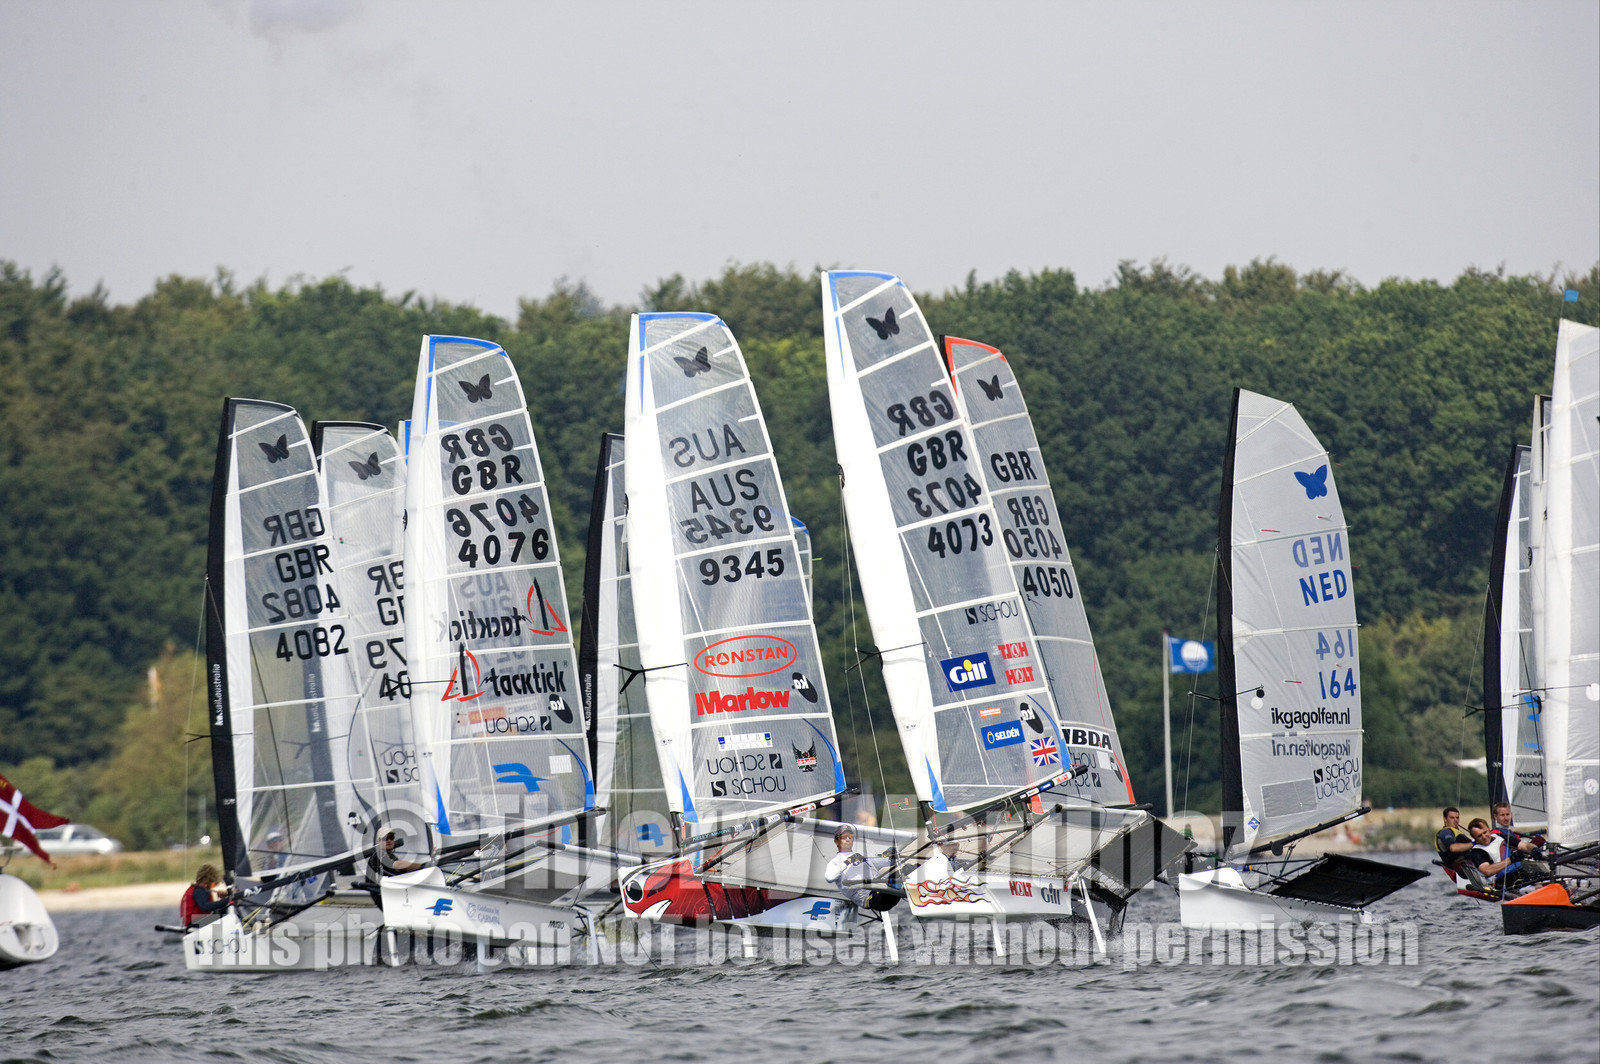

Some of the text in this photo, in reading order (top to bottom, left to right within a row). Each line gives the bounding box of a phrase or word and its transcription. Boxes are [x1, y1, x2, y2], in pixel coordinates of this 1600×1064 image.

[907, 430, 968, 476] GBR
[990, 451, 1037, 483] GBR
[452, 455, 523, 495] GBR
[690, 469, 759, 513] AUS
[458, 528, 548, 568] 4076
[928, 513, 993, 558] 4073
[275, 544, 333, 582] GBR
[699, 548, 784, 585] 9345
[1023, 566, 1073, 599] 4050
[1299, 569, 1347, 606] NED
[979, 600, 1018, 623] SCHOU
[276, 624, 349, 662] 4082
[704, 646, 788, 668] RONSTAN
[379, 670, 412, 701] 40
[487, 661, 567, 697] tacktick
[949, 661, 988, 684] Gill
[1005, 666, 1034, 685] HOLT
[1319, 668, 1357, 699] 164
[695, 687, 790, 716] Marlow
[1271, 707, 1351, 729] ikgagolfen.nl
[995, 727, 1020, 741] SELDÉN
[1325, 758, 1359, 781] SCHOU
[732, 775, 786, 796] SCHOU
[692, 828, 731, 842] KELLY MARINE
[1009, 881, 1032, 897] HOLT
[1041, 883, 1060, 905] Gill
[209, 938, 248, 955] SCHOU
